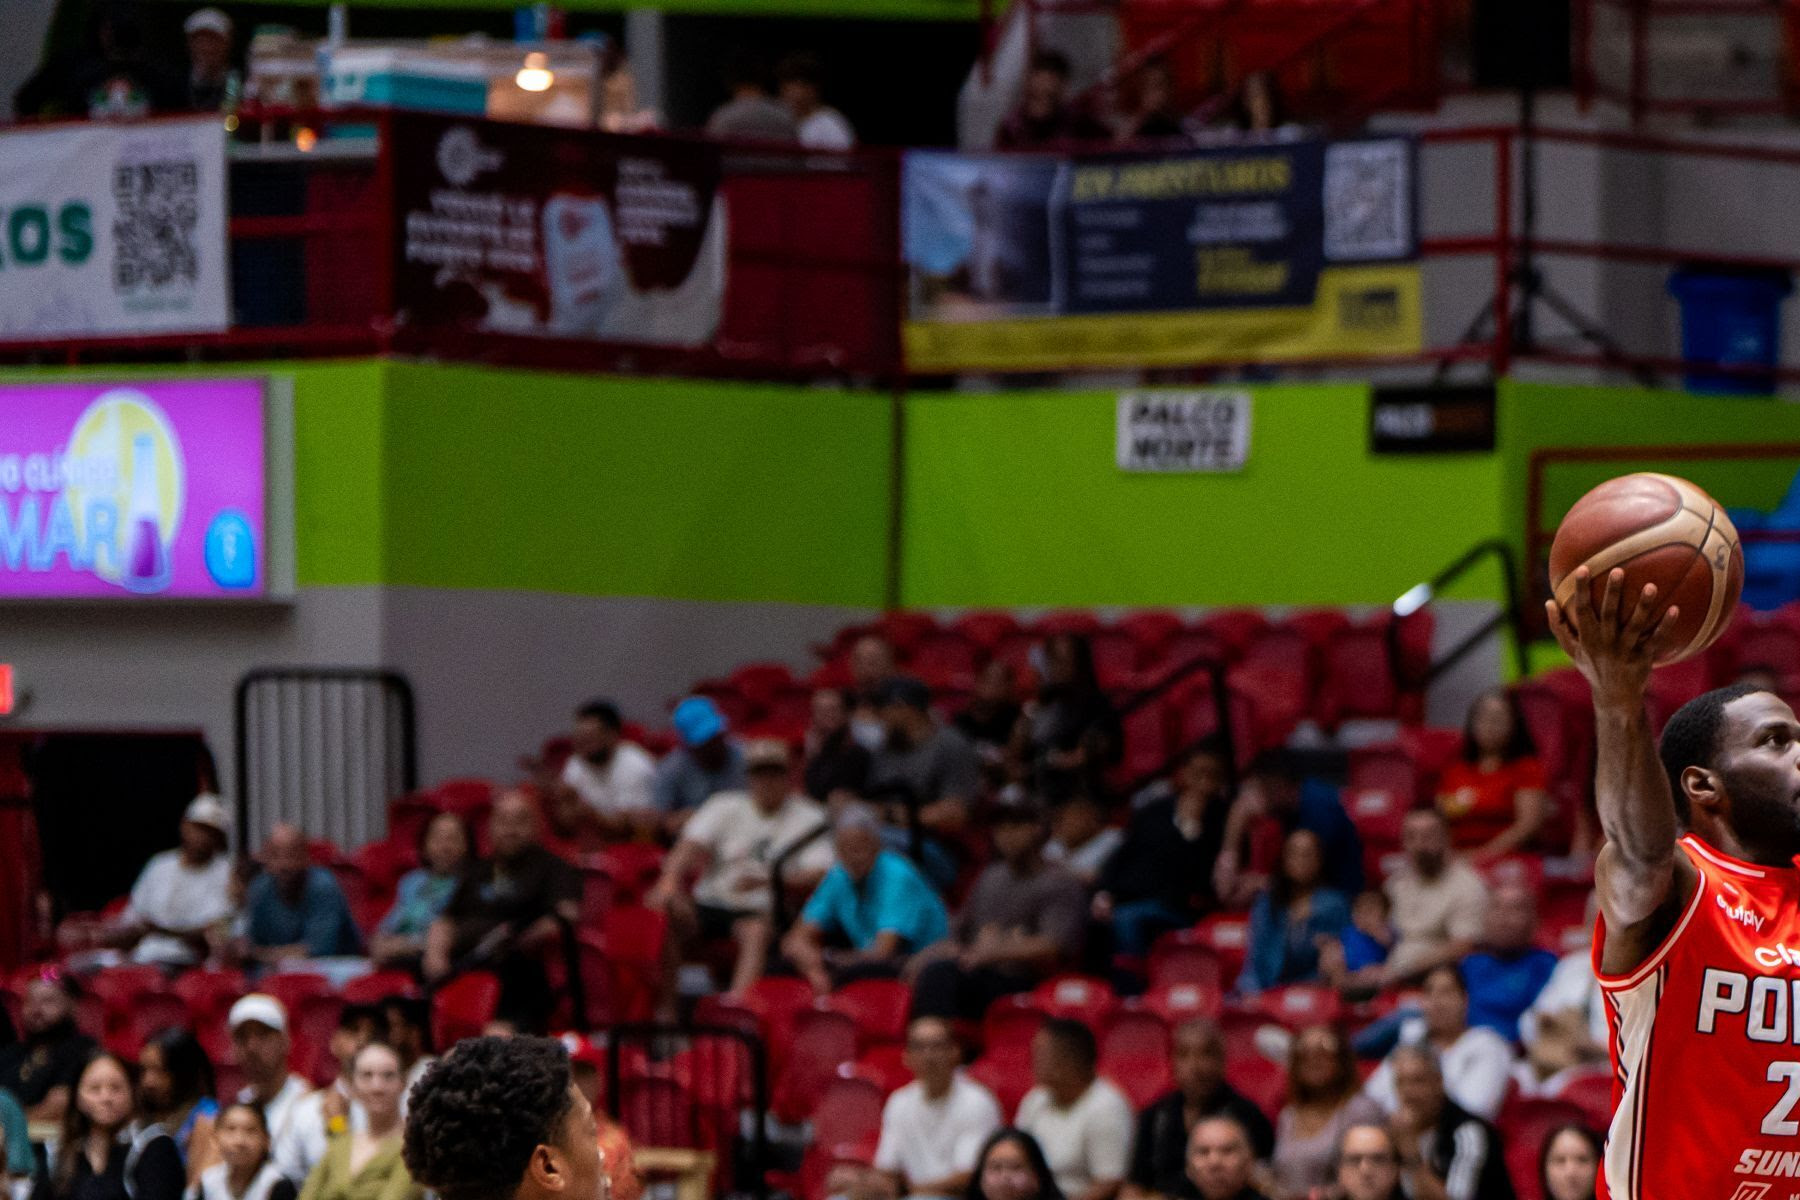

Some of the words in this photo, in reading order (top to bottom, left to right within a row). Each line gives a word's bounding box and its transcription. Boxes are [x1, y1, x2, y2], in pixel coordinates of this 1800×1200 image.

[0, 200, 94, 269] OS
[1130, 399, 1234, 426] PALCO
[1130, 436, 1234, 461] NORTE
